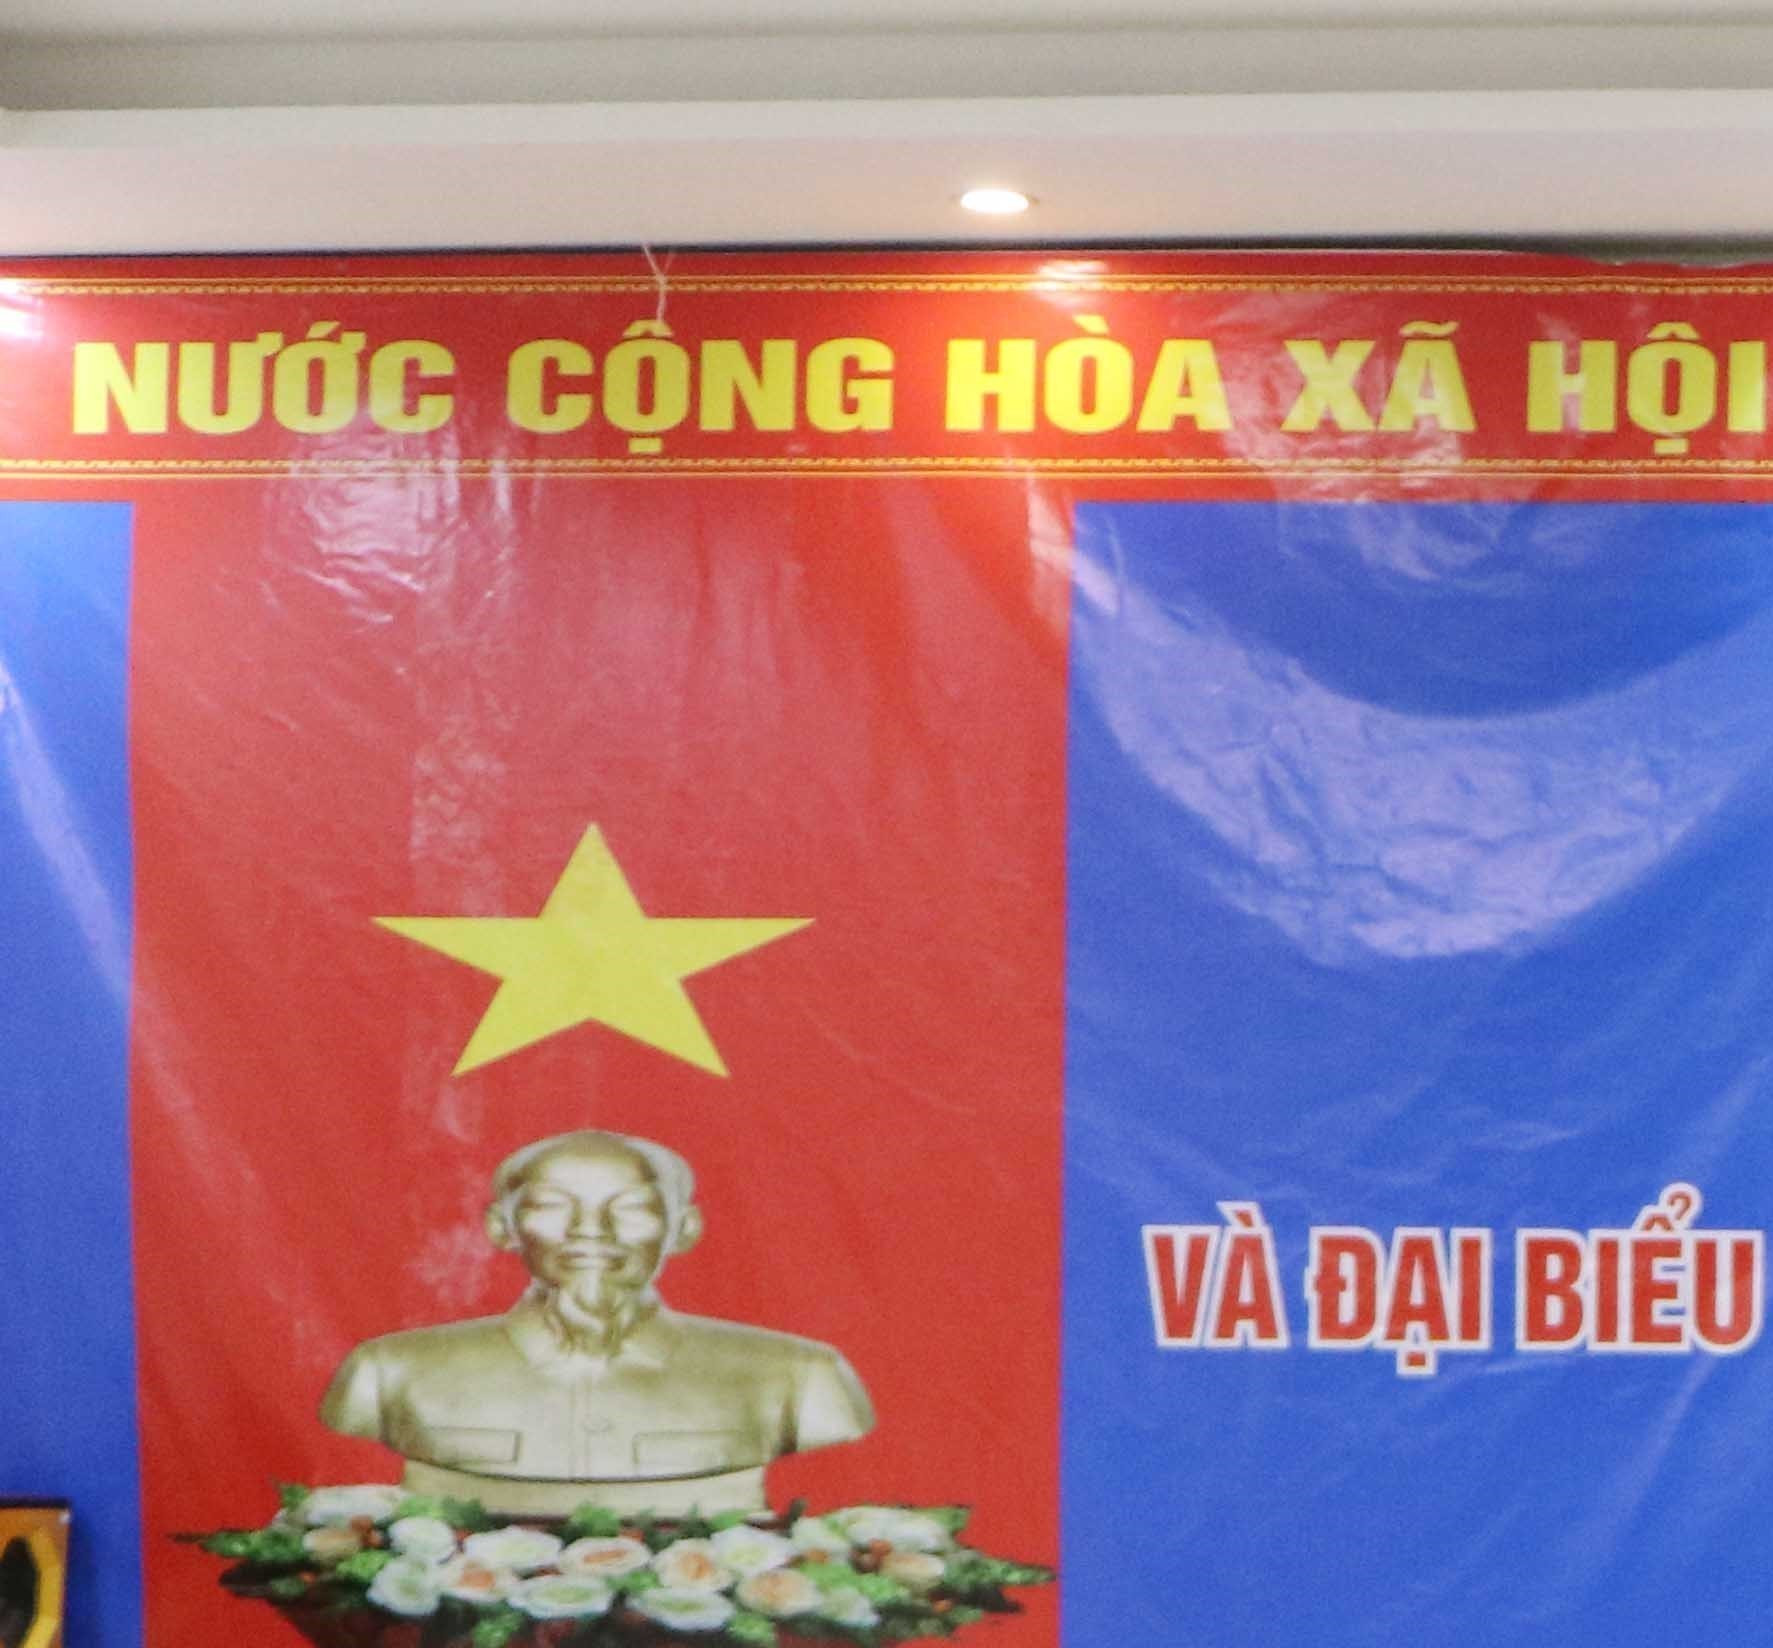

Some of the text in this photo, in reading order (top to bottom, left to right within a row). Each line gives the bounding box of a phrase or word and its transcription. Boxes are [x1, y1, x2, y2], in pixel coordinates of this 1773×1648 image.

[73, 320, 454, 436] NƯỚC
[507, 320, 893, 454] CỘNG
[945, 314, 1234, 434] HÒA
[1280, 320, 1475, 433] XÃ
[1527, 321, 1766, 456] HỘI
[1142, 1202, 1290, 1351] VÀ
[1304, 1225, 1492, 1377] ĐẠI
[1514, 1182, 1765, 1355] BIỂU
